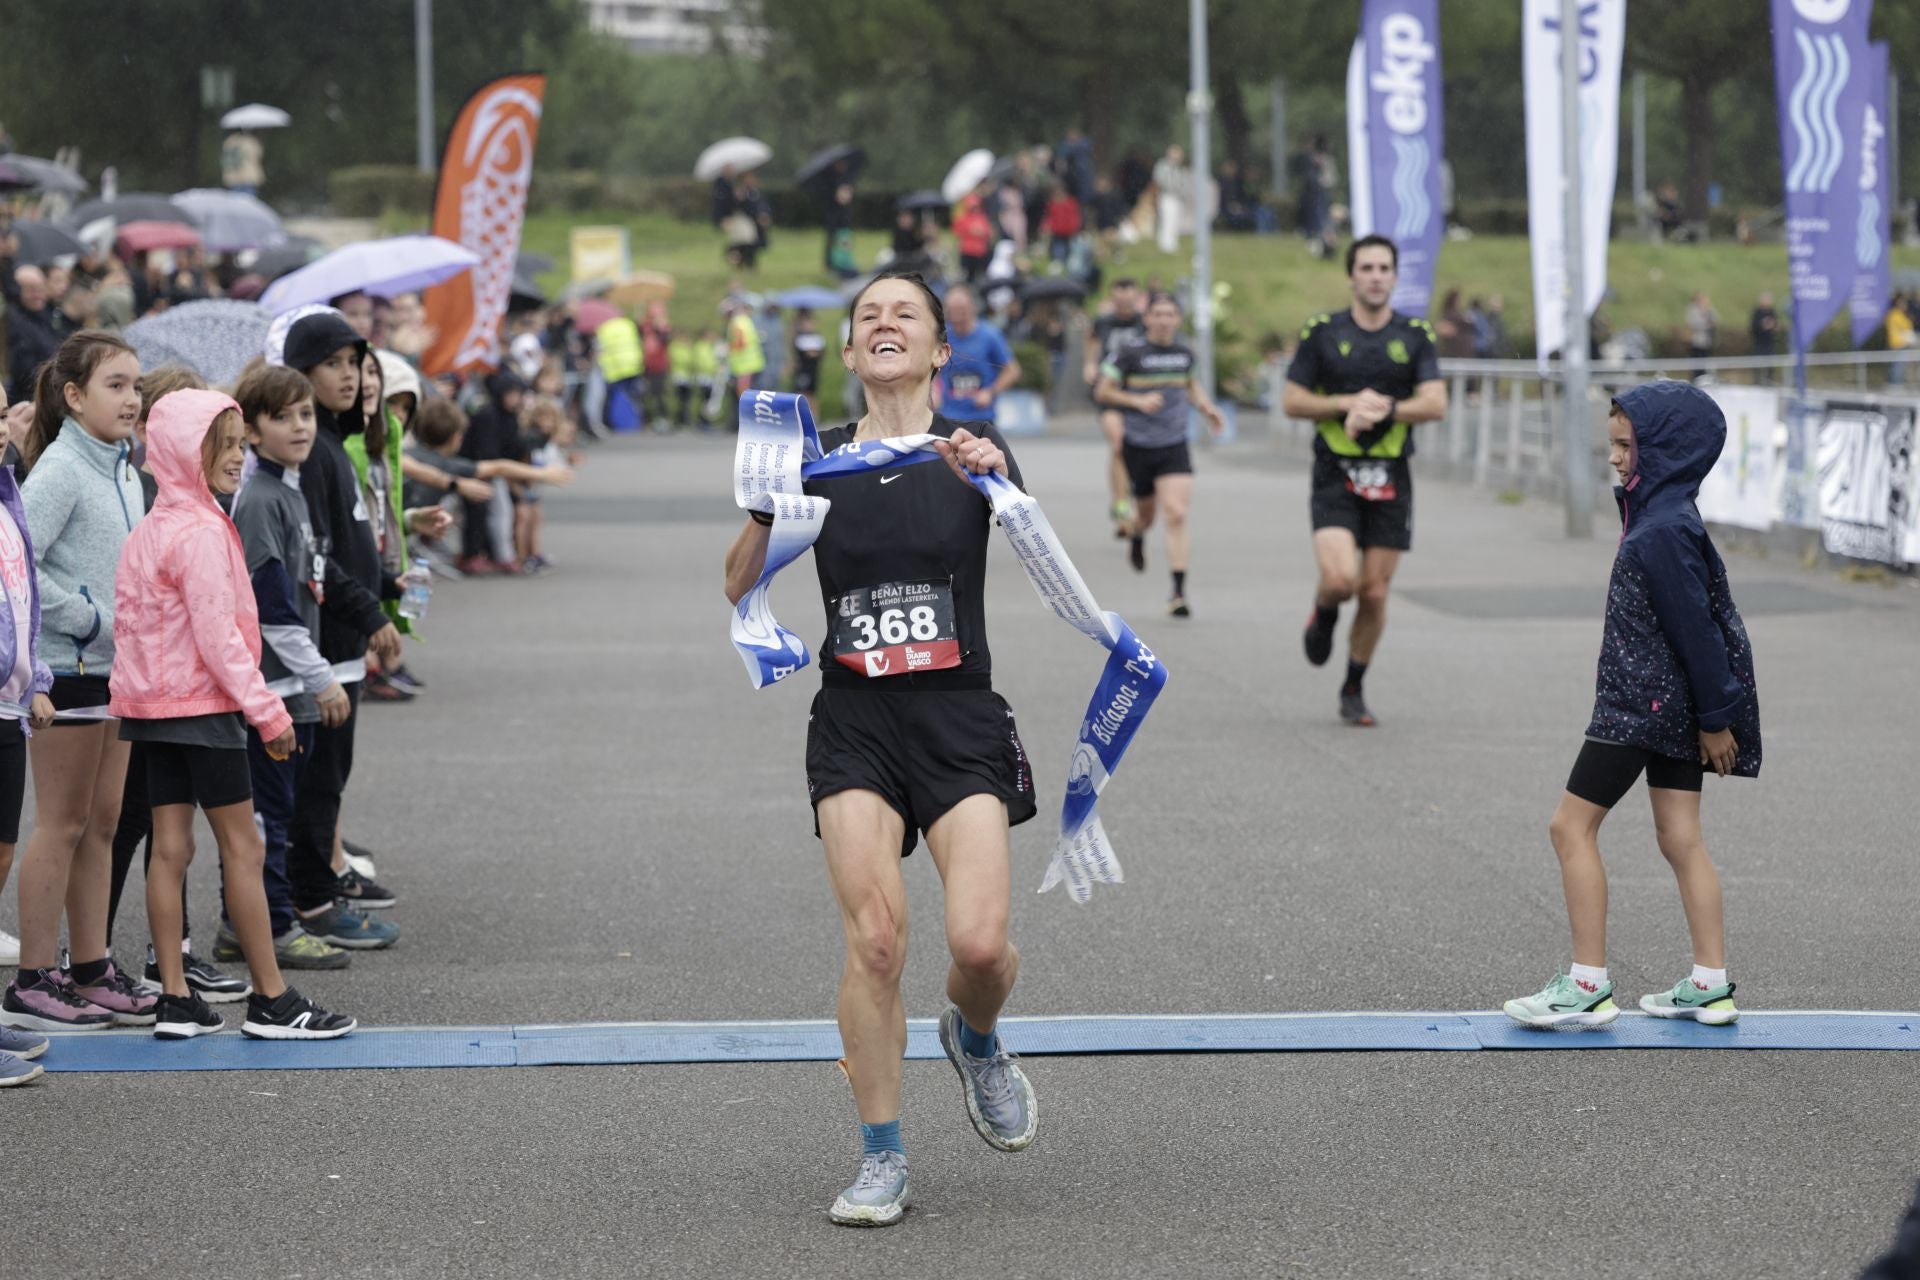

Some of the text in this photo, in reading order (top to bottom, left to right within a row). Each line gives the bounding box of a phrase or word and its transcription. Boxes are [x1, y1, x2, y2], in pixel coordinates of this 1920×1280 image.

[1370, 12, 1436, 135] ekp
[871, 583, 931, 601] BEÑAT ELZO
[878, 597, 901, 607] MENDI
[901, 593, 940, 604] LASTERKETA
[850, 605, 939, 650] 368
[906, 651, 932, 661] DIARIO
[907, 658, 932, 667] VASCO
[1091, 684, 1140, 746] Bidasoa
